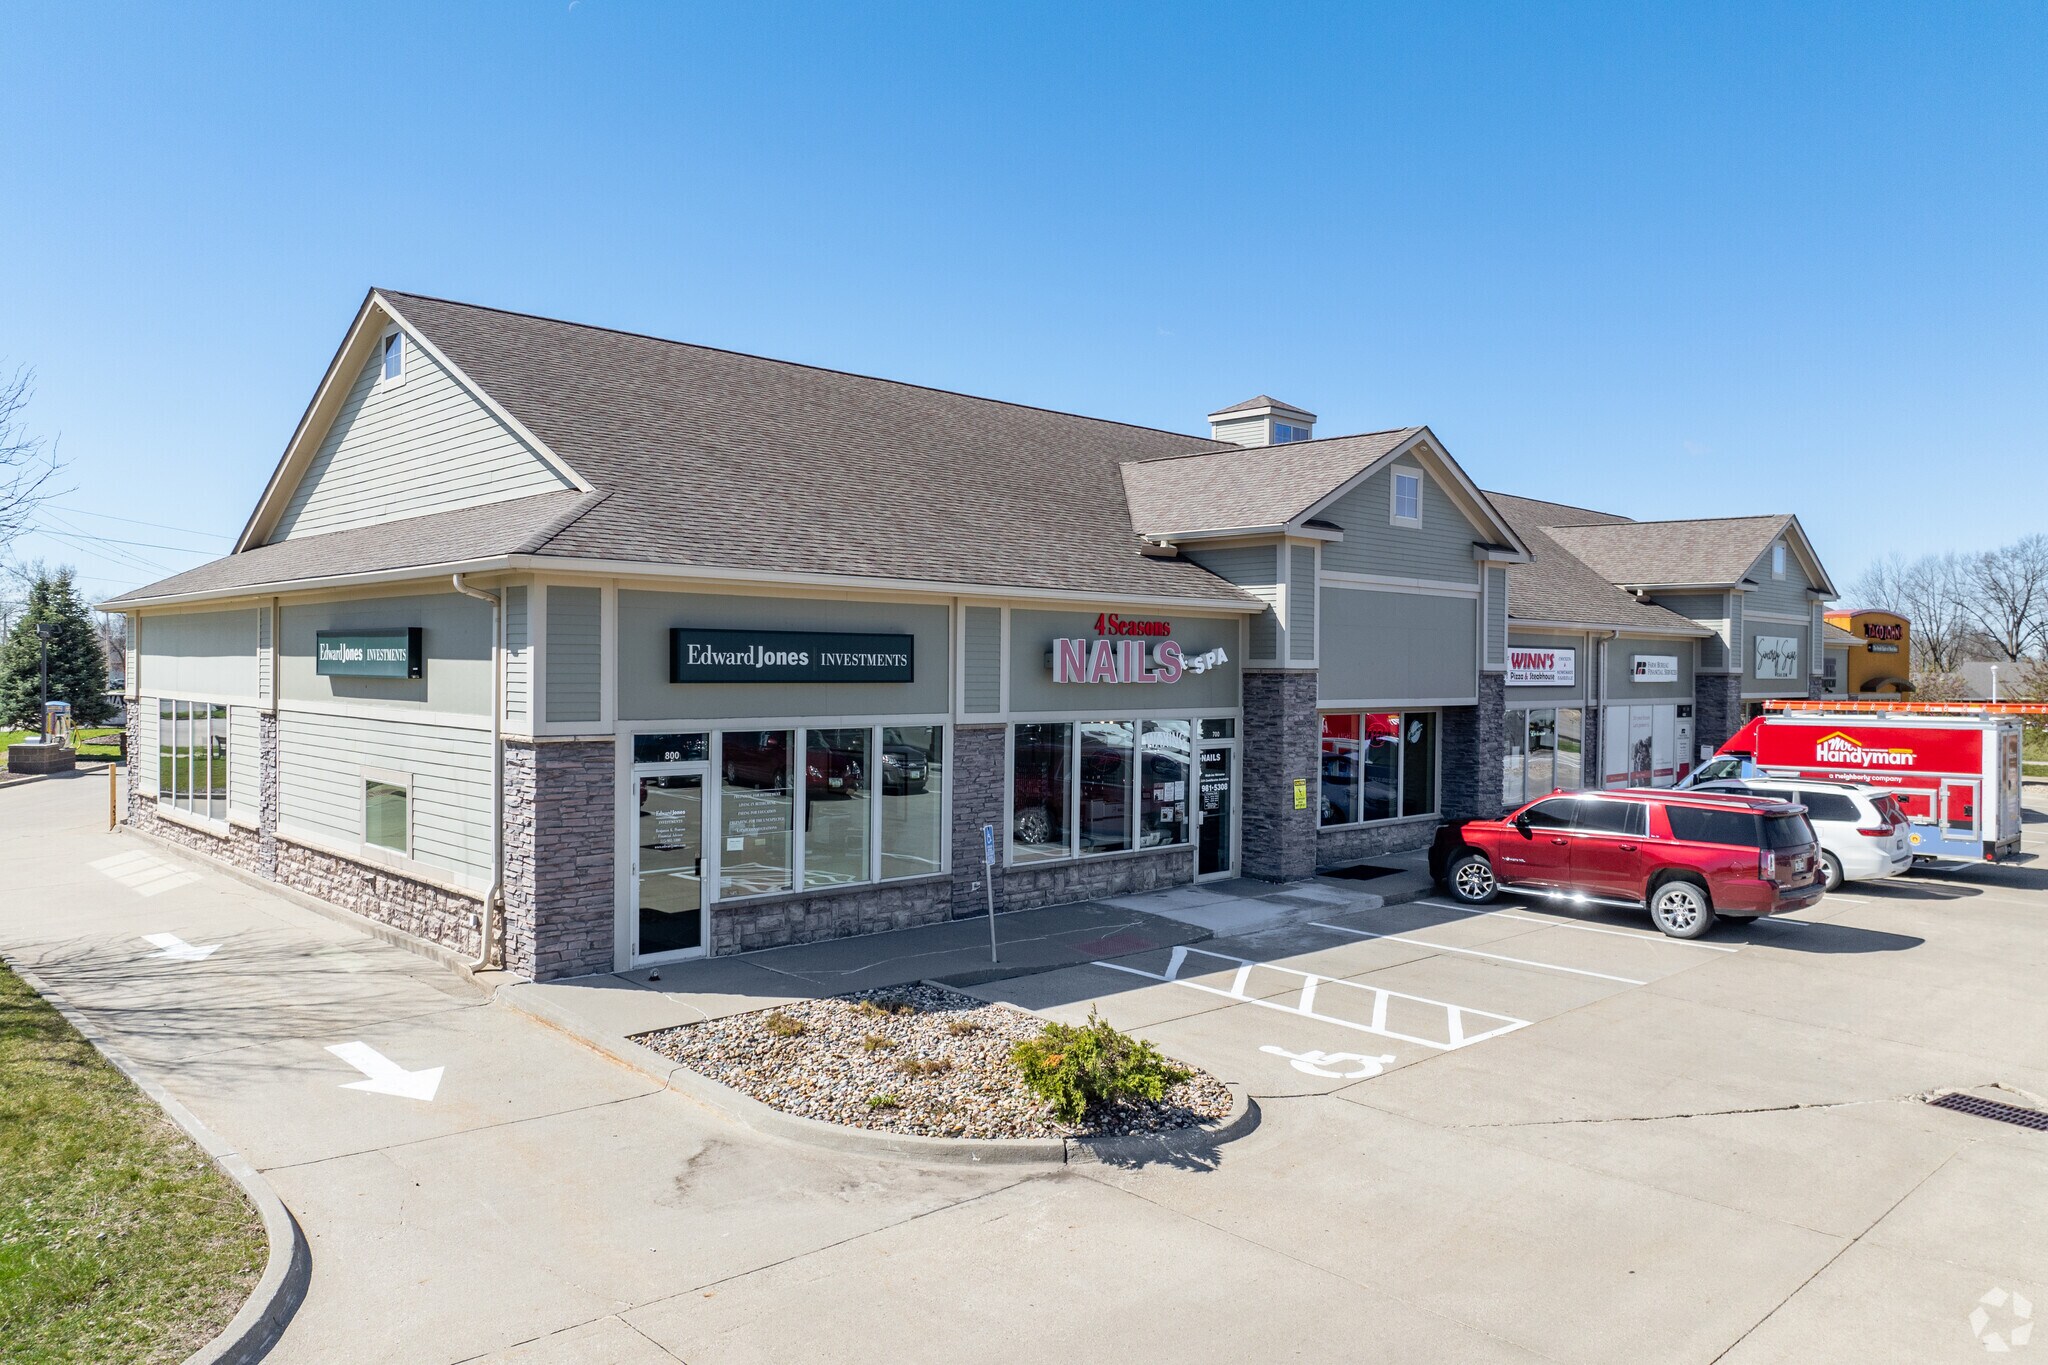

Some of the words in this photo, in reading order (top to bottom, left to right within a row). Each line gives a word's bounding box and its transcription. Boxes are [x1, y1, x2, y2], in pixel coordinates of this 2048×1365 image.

[1094, 613, 1105, 635] 4
[1108, 614, 1170, 636] Seasons
[366, 648, 407, 662] INVESTMENTS
[687, 643, 809, 668] EdwardJones
[820, 652, 908, 667] INVESTMENTS
[1053, 638, 1183, 684] NAILS
[1189, 648, 1229, 674] SPA
[1511, 652, 1555, 670] WINN'S
[1510, 672, 1523, 680] Pizza
[1828, 736, 1858, 751] Mr.
[665, 751, 680, 760] 800
[1201, 753, 1221, 762] NAILS
[1816, 742, 1913, 767] Handyman
[1835, 773, 1871, 782] neighborly
[1871, 775, 1903, 783] company
